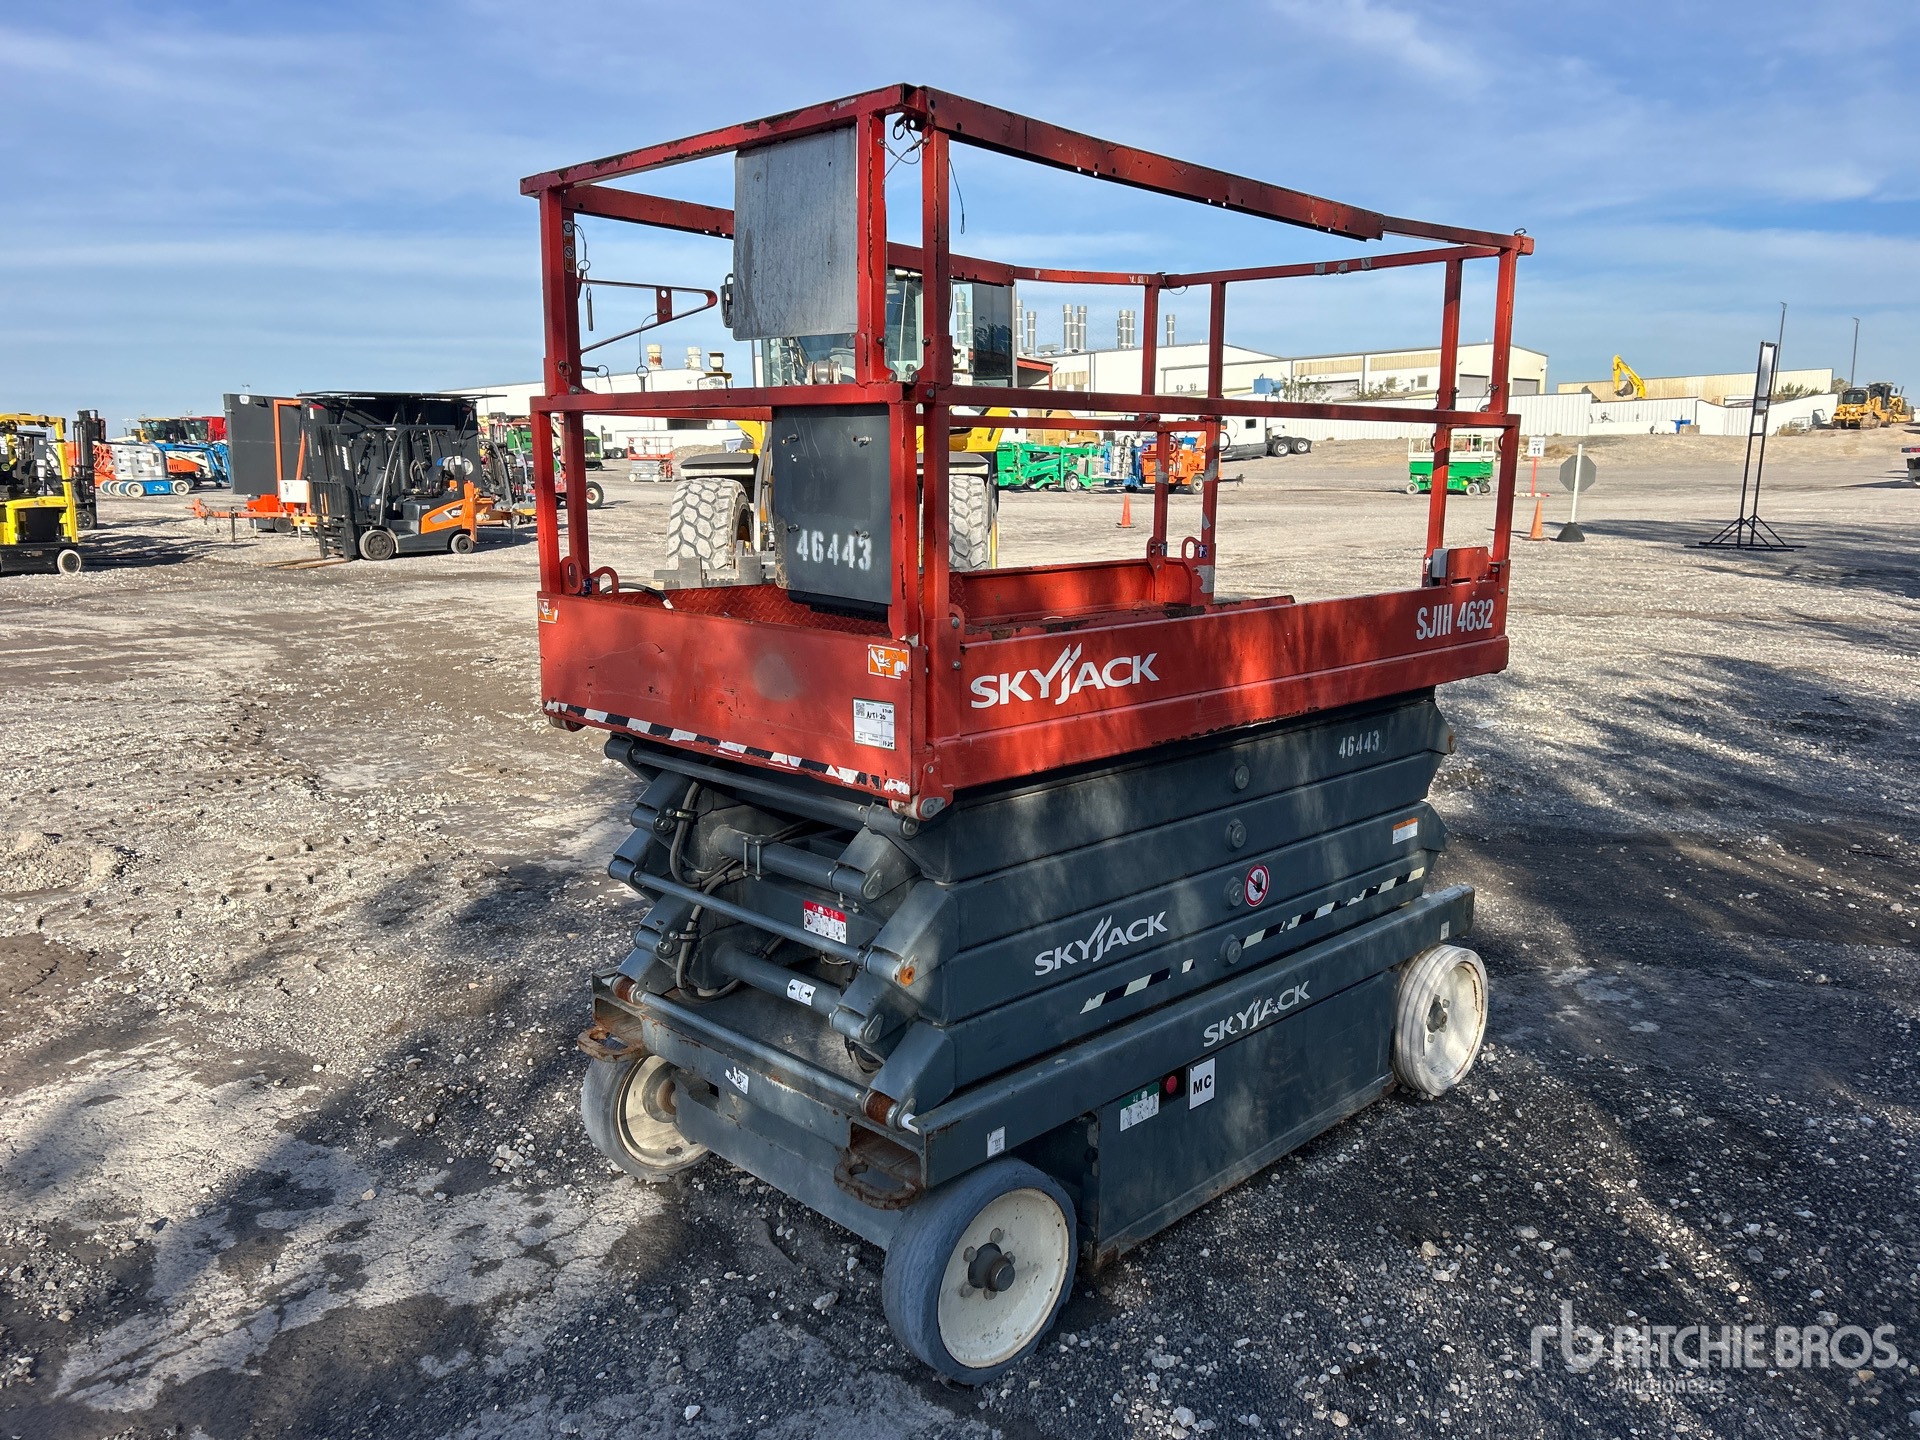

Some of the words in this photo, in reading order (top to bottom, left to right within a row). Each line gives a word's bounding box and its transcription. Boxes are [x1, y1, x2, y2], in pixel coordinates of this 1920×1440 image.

[796, 528, 872, 571] 46443
[1456, 598, 1495, 633] 4632
[970, 642, 1160, 709] SKYJACK
[1338, 729, 1380, 759] 46443
[1034, 910, 1168, 976] SKYJACK
[1203, 980, 1311, 1048] SKYJACK
[1193, 1074, 1213, 1096] MC
